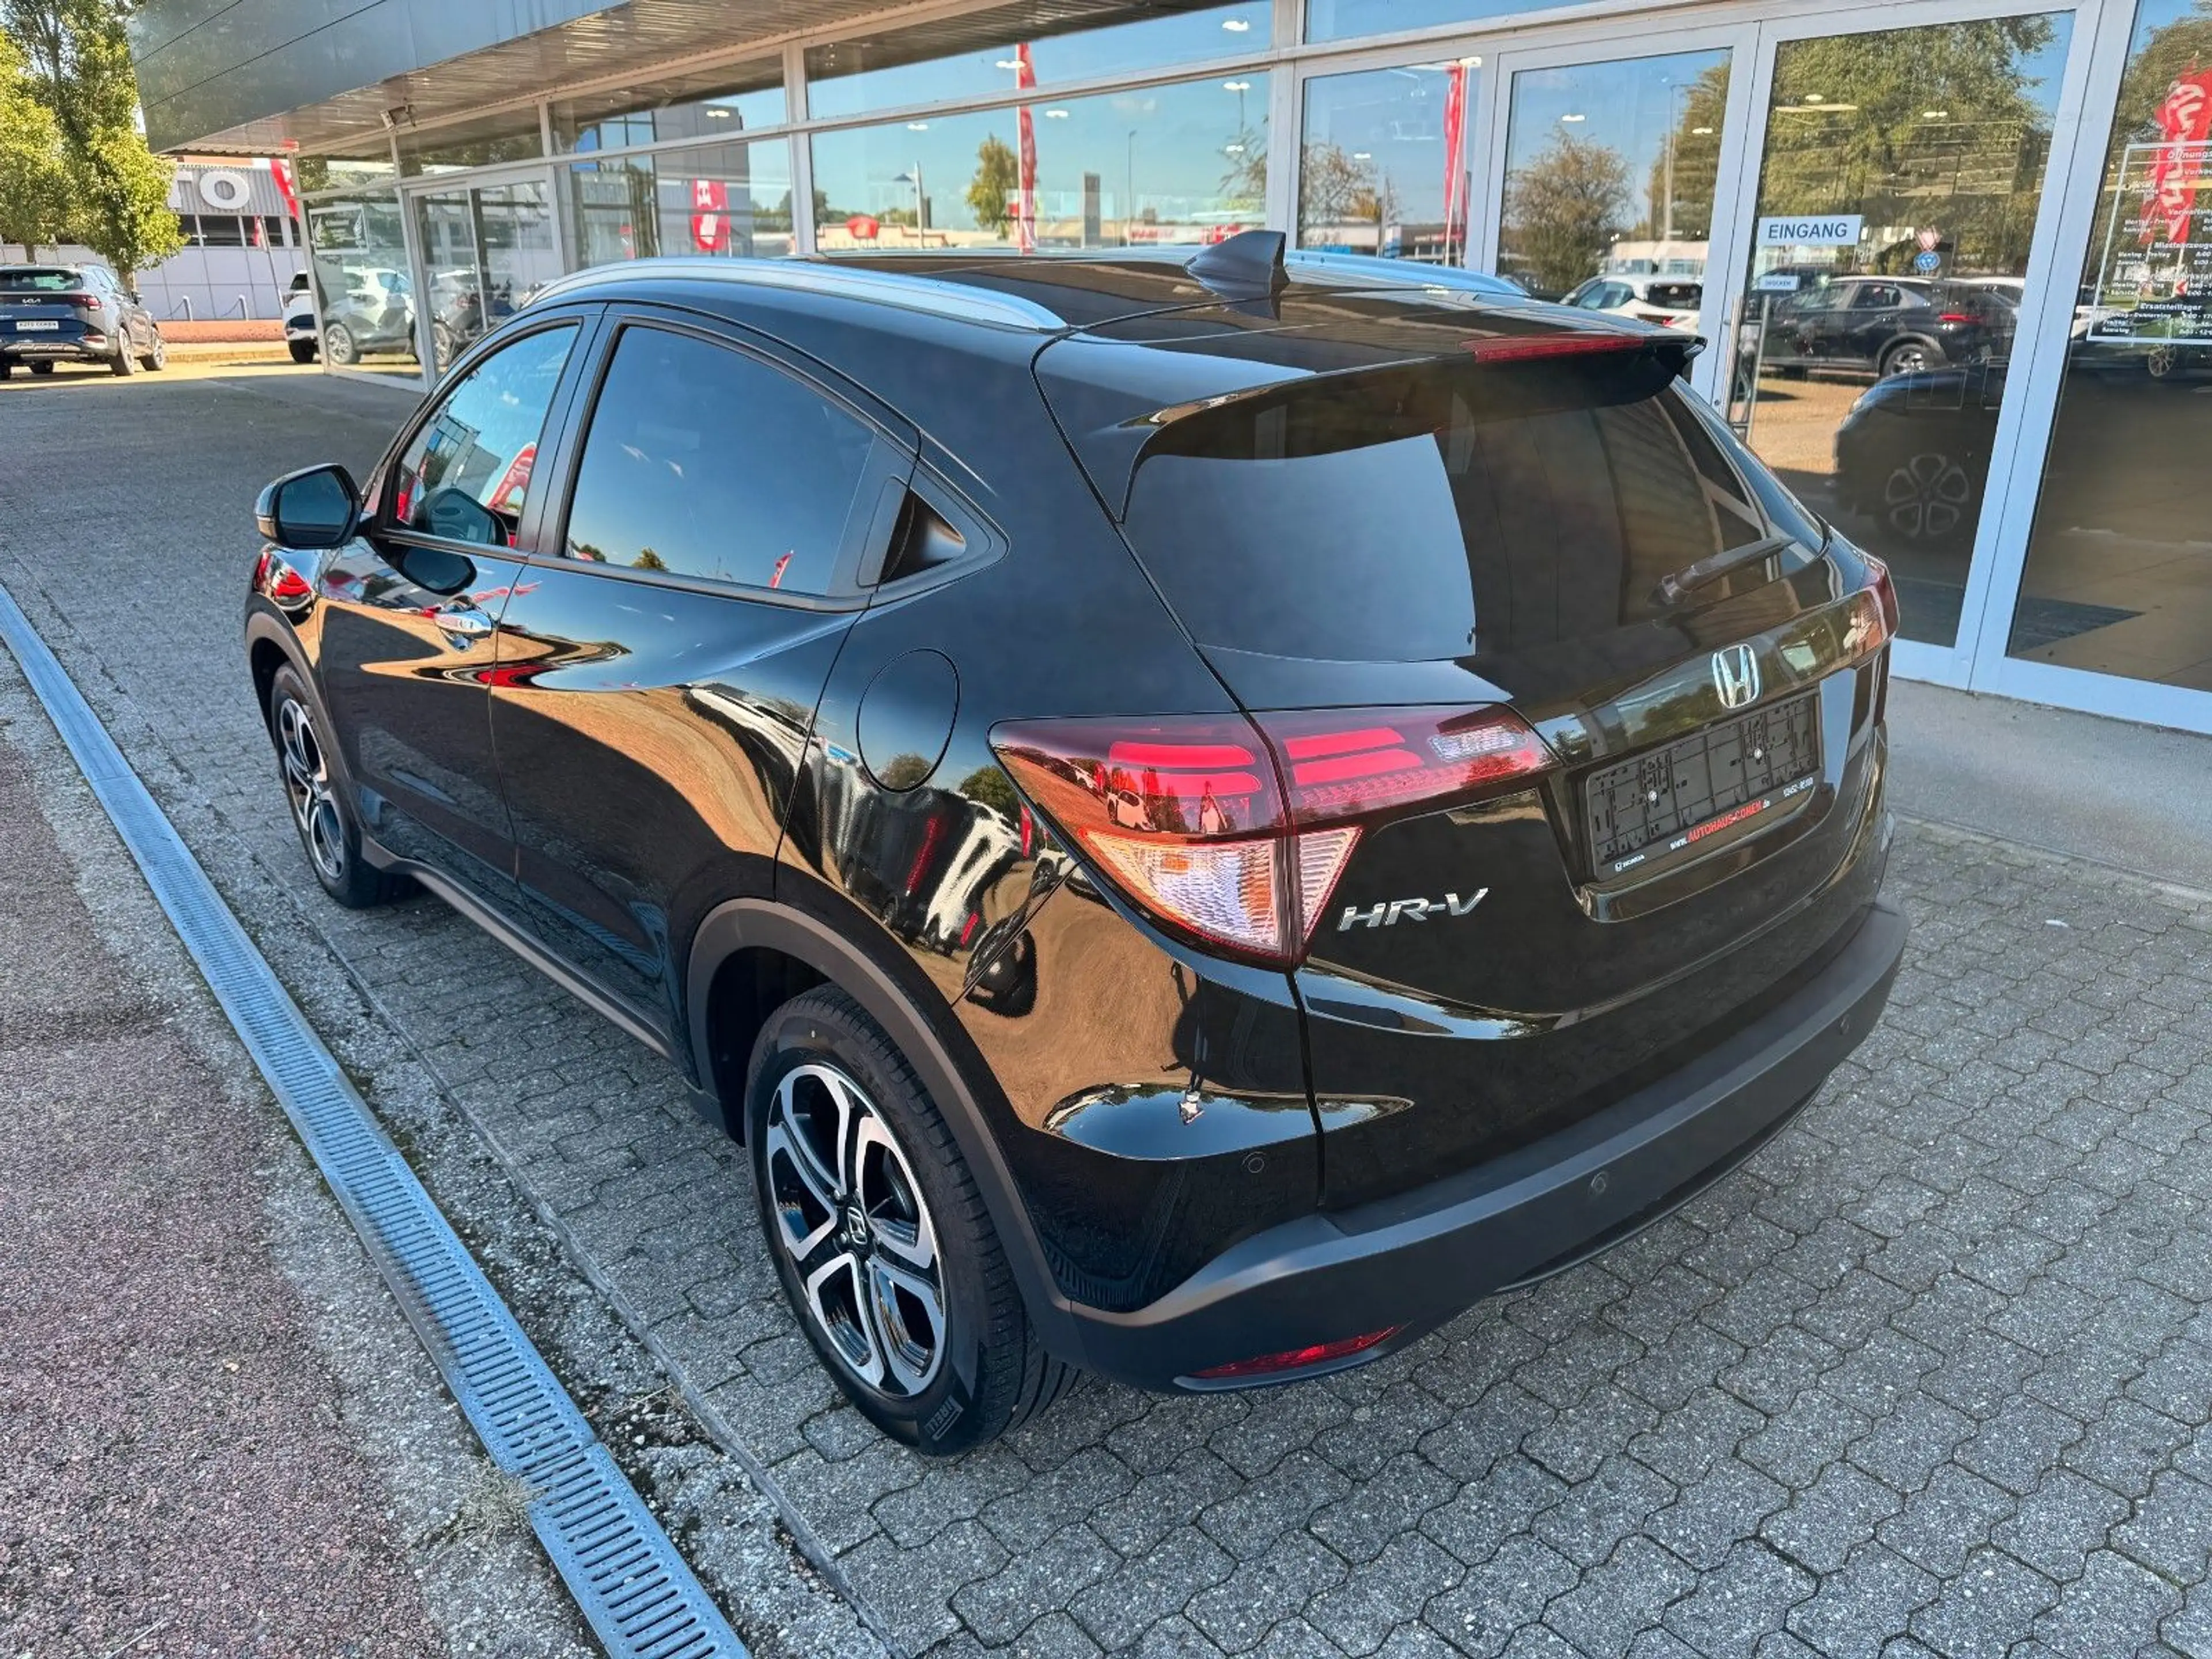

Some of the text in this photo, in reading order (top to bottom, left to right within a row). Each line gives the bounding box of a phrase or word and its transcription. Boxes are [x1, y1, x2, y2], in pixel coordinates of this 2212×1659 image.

[1768, 222, 1847, 239] EINGANG
[2140, 303, 2202, 311] Ersatzteillager
[1336, 887, 1489, 931] HR-V
